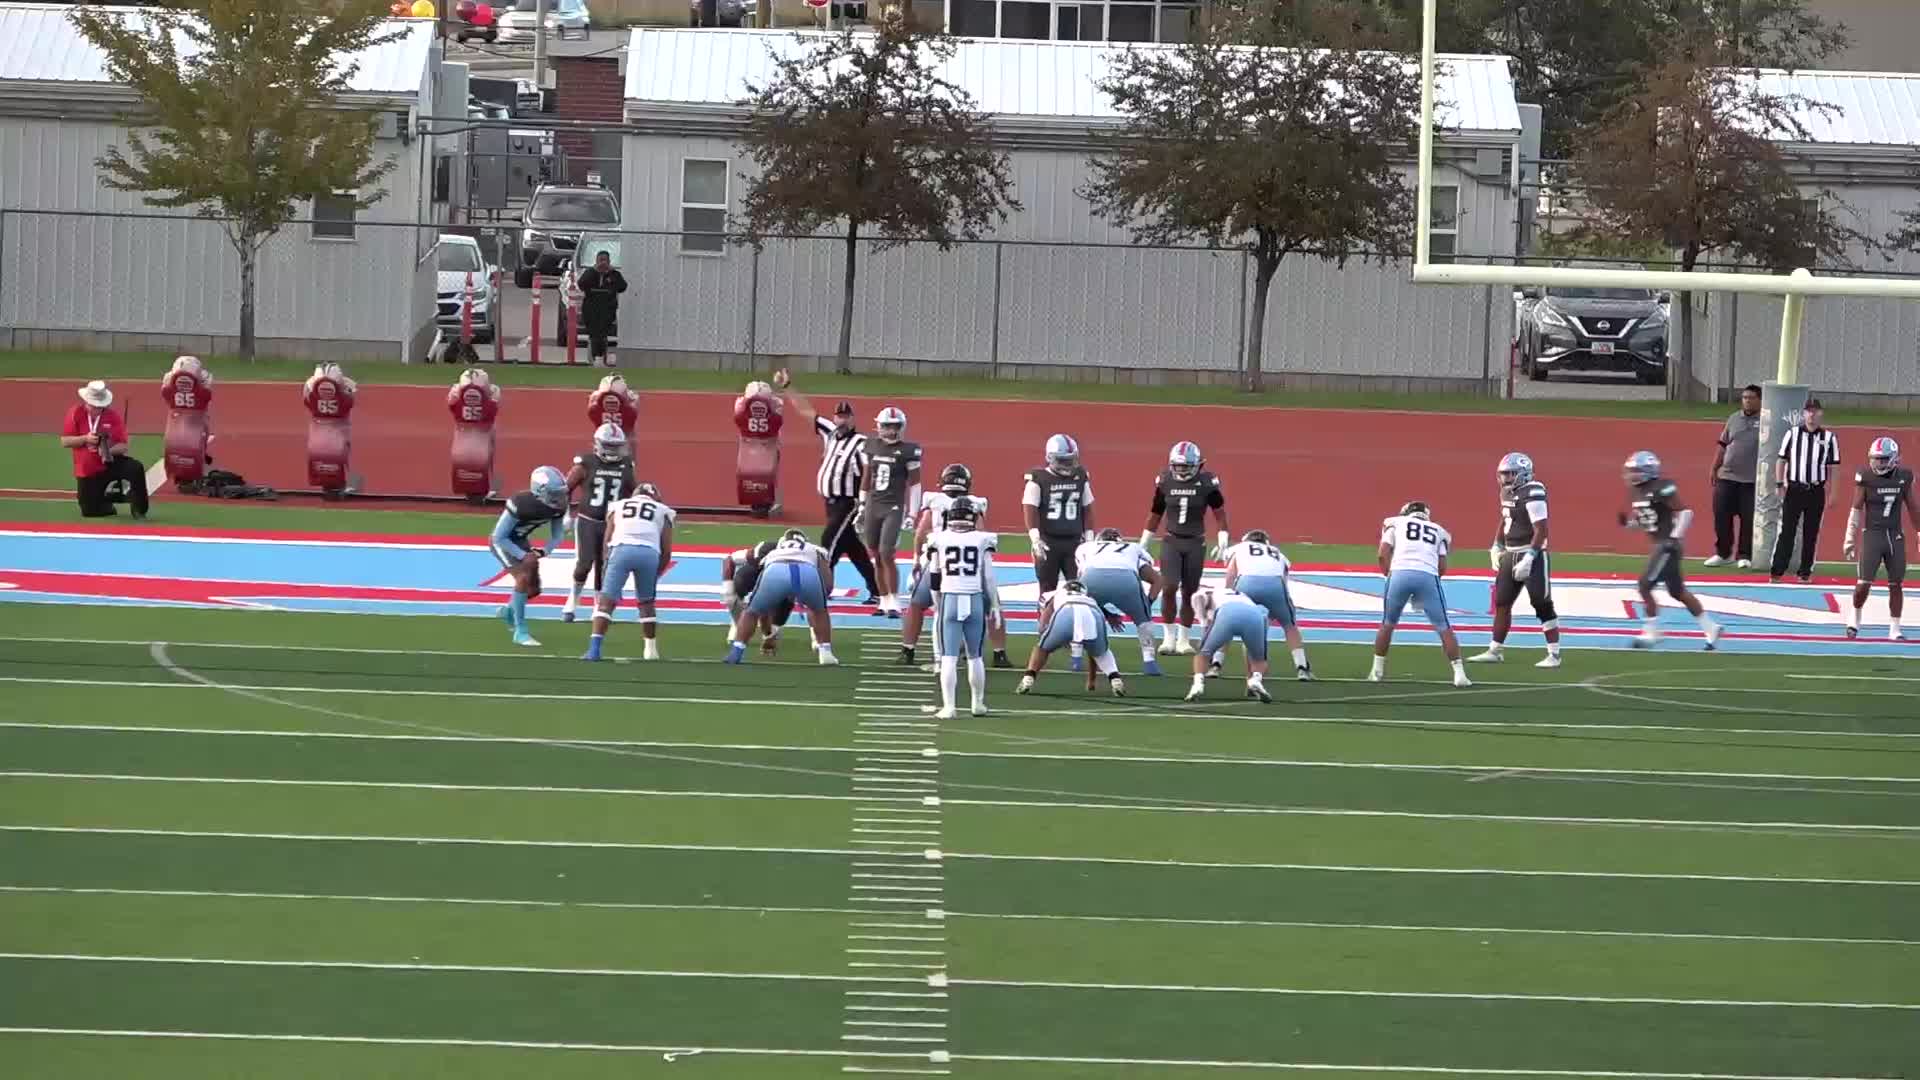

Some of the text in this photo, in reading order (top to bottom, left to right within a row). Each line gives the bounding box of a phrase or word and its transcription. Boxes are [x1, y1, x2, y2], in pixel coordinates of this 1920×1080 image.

[174, 392, 196, 407] 65
[317, 399, 339, 414] 65
[462, 405, 483, 420] 65
[748, 418, 769, 432] 65
[590, 477, 622, 507] 33
[622, 501, 657, 521] 56
[1046, 491, 1080, 520] 56
[1178, 497, 1189, 524] 1
[1883, 495, 1895, 517] 7
[1406, 521, 1438, 546] 85
[945, 546, 977, 576] 29
